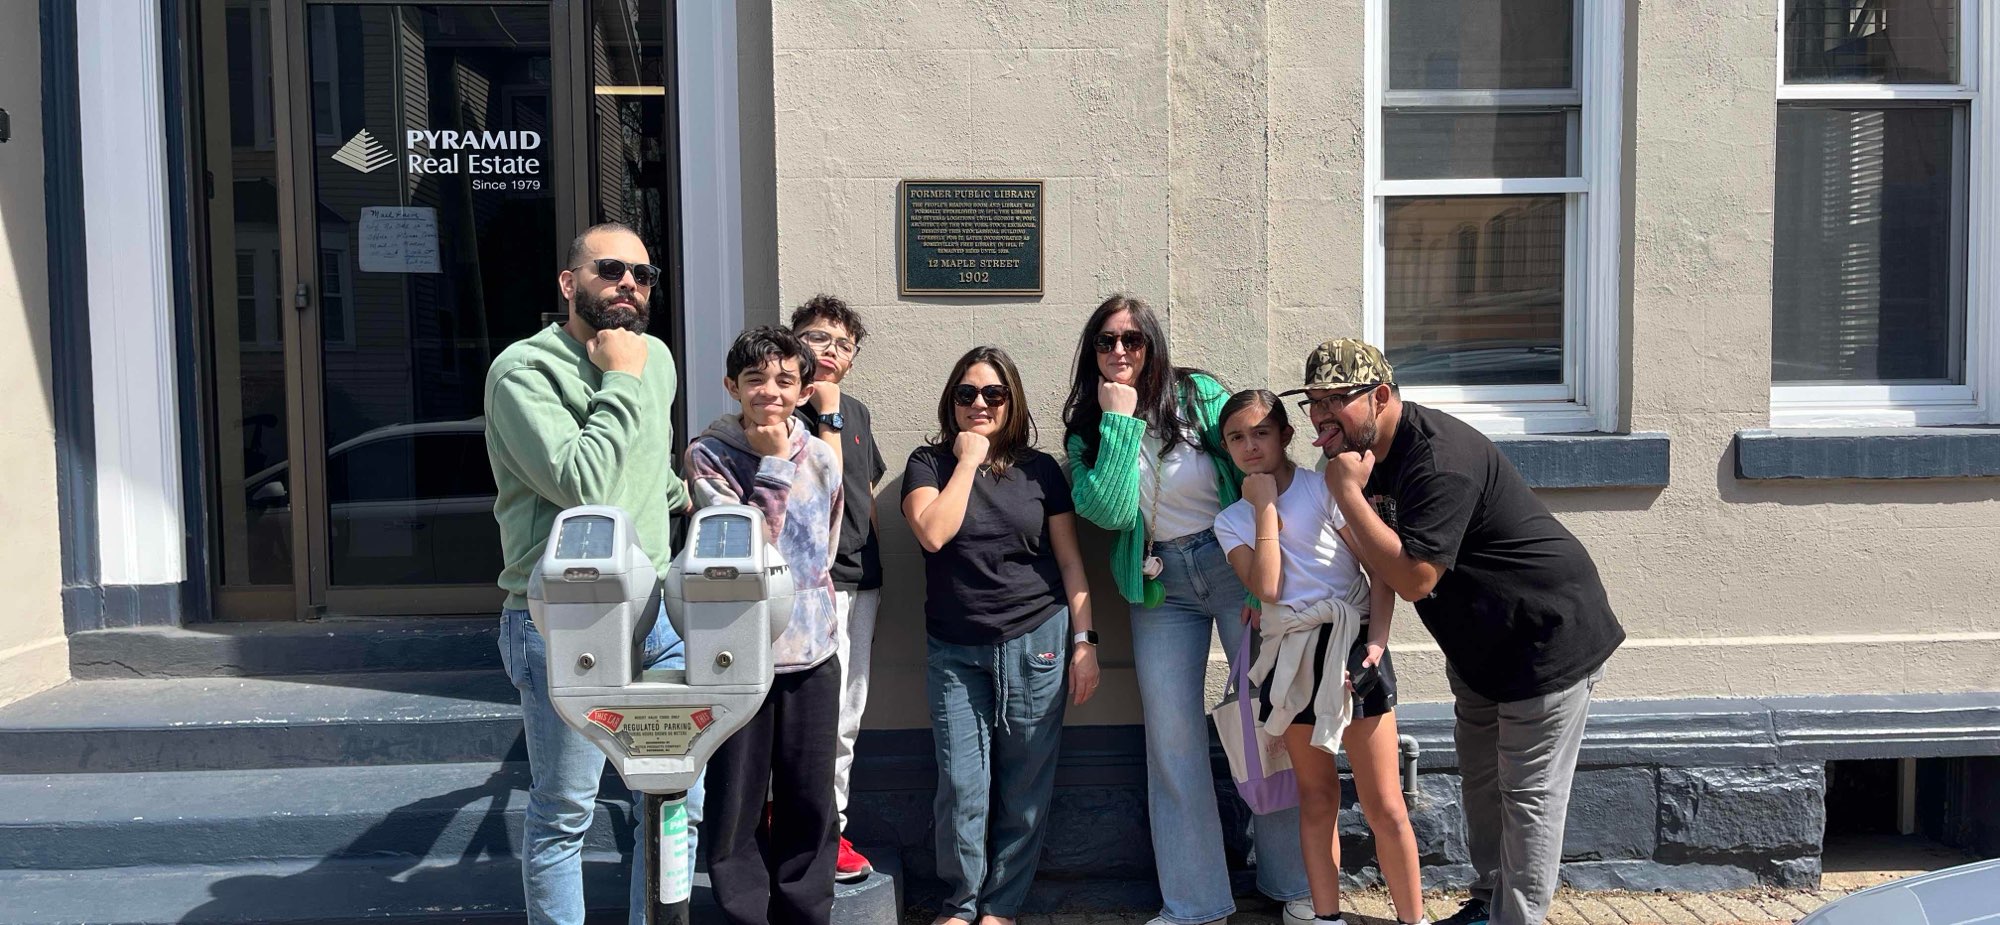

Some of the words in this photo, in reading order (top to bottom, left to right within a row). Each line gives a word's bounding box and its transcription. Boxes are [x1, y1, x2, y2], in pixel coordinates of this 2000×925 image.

[406, 130, 540, 150] PYRAMID
[408, 153, 458, 174] Real
[468, 154, 540, 174] Estate
[472, 180, 506, 190] Since
[511, 180, 540, 190] 1979
[911, 190, 952, 198] FORMER
[954, 190, 990, 198] PUBLIC
[994, 190, 1036, 198] LIBRARY
[928, 259, 938, 268] 12
[941, 259, 976, 268] MAPLE
[980, 259, 1020, 268] STREET
[959, 272, 989, 283] 1902
[664, 722, 692, 730] PARKING
